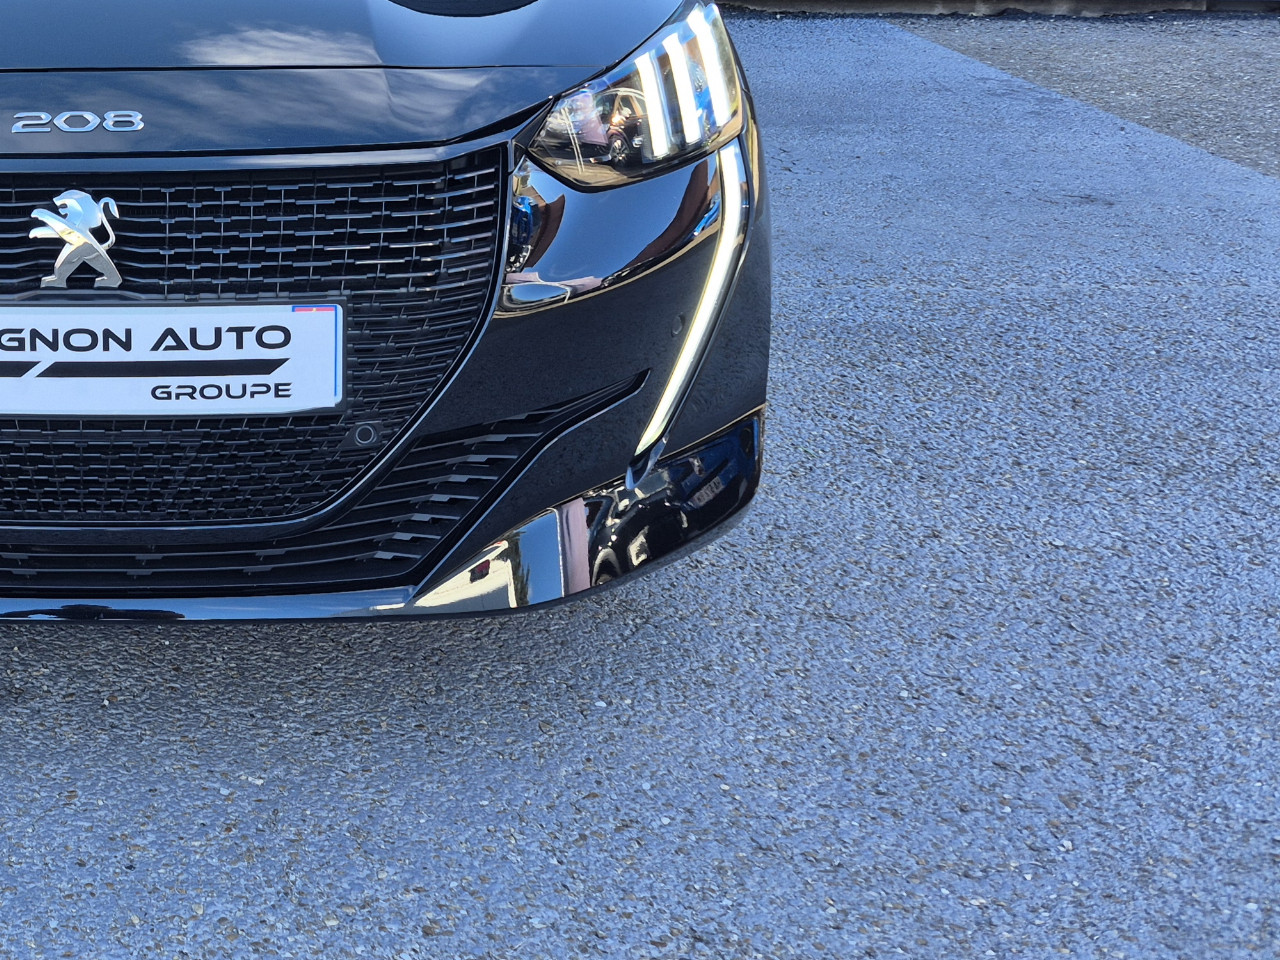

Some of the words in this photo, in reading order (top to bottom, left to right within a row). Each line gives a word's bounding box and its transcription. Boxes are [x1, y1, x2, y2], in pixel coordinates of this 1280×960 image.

[10, 110, 146, 134] 208
[149, 324, 293, 352] AUTO
[150, 381, 293, 401] GROUPE
